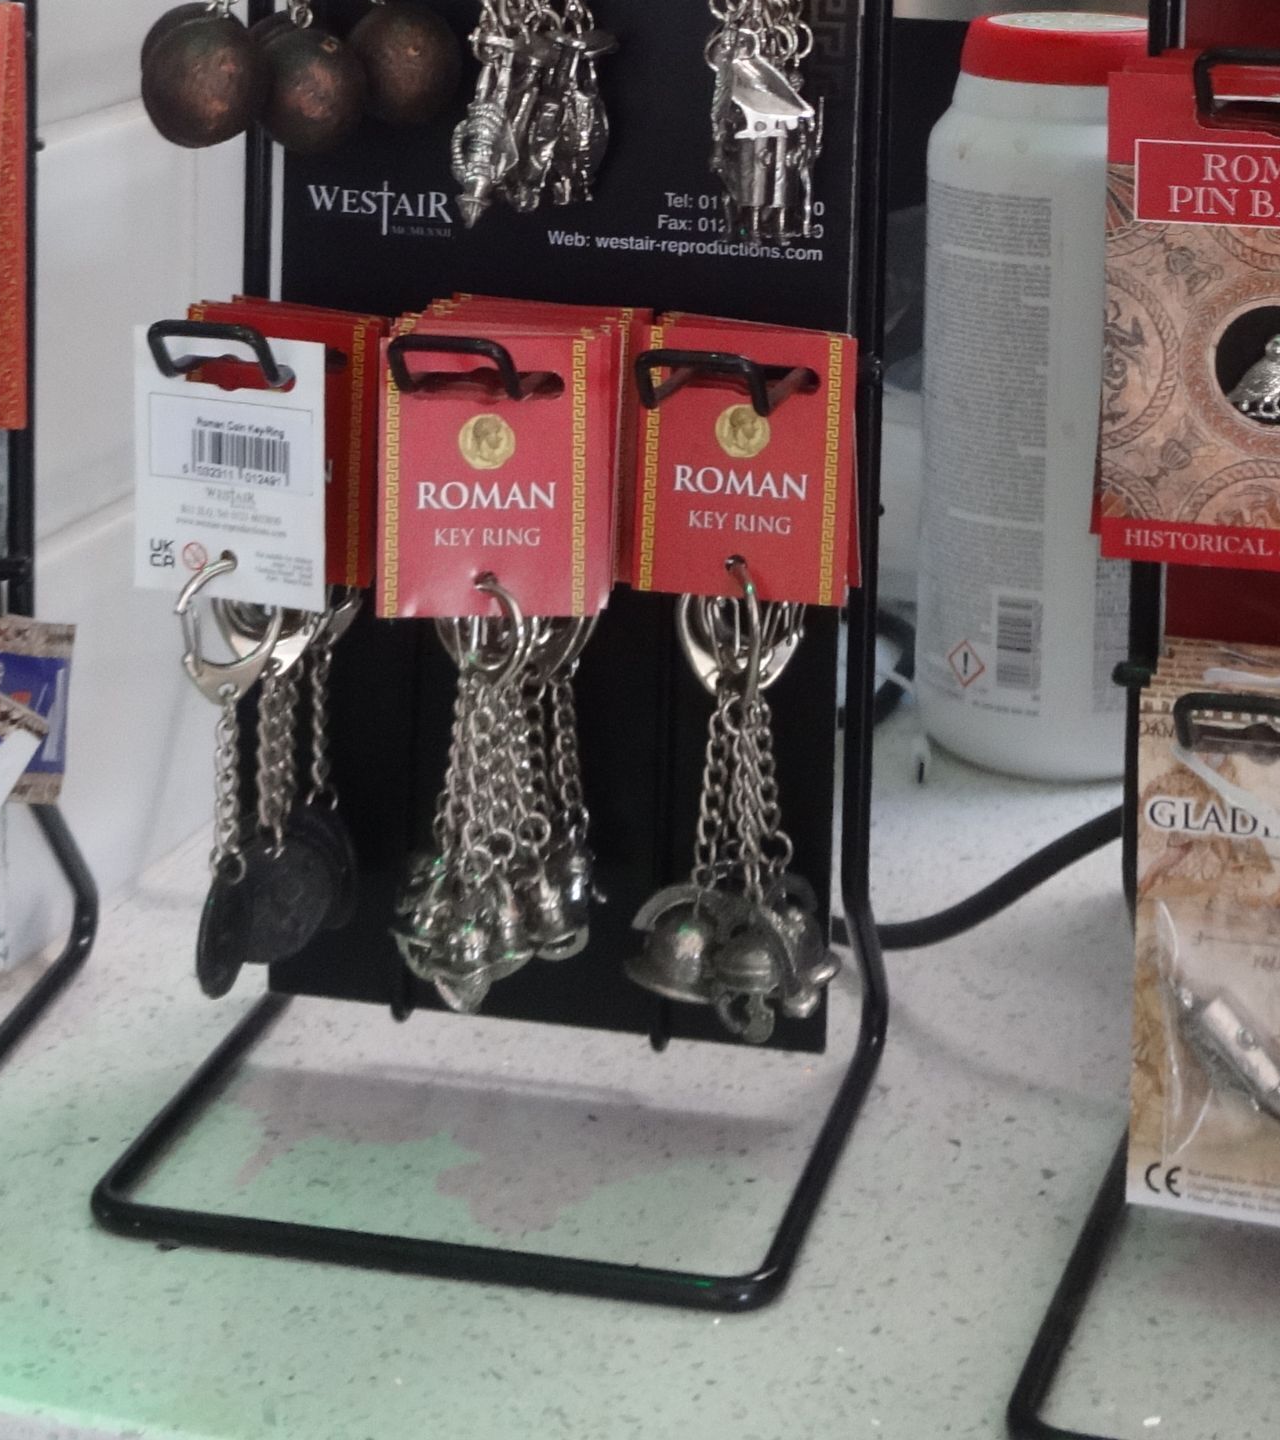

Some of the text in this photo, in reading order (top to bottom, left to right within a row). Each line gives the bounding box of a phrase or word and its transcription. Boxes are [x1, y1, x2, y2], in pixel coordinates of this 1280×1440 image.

[664, 191, 694, 208] Tel:
[1168, 185, 1240, 216] PIN
[658, 214, 693, 231] Fax:
[548, 229, 823, 261] Web: westair-reproductions.com
[417, 481, 557, 511] ROMAN
[674, 464, 808, 502] ROMAN
[434, 527, 541, 549] KEY RING
[689, 510, 792, 536] KEY RING
[1123, 527, 1273, 557] HISTORICAL
